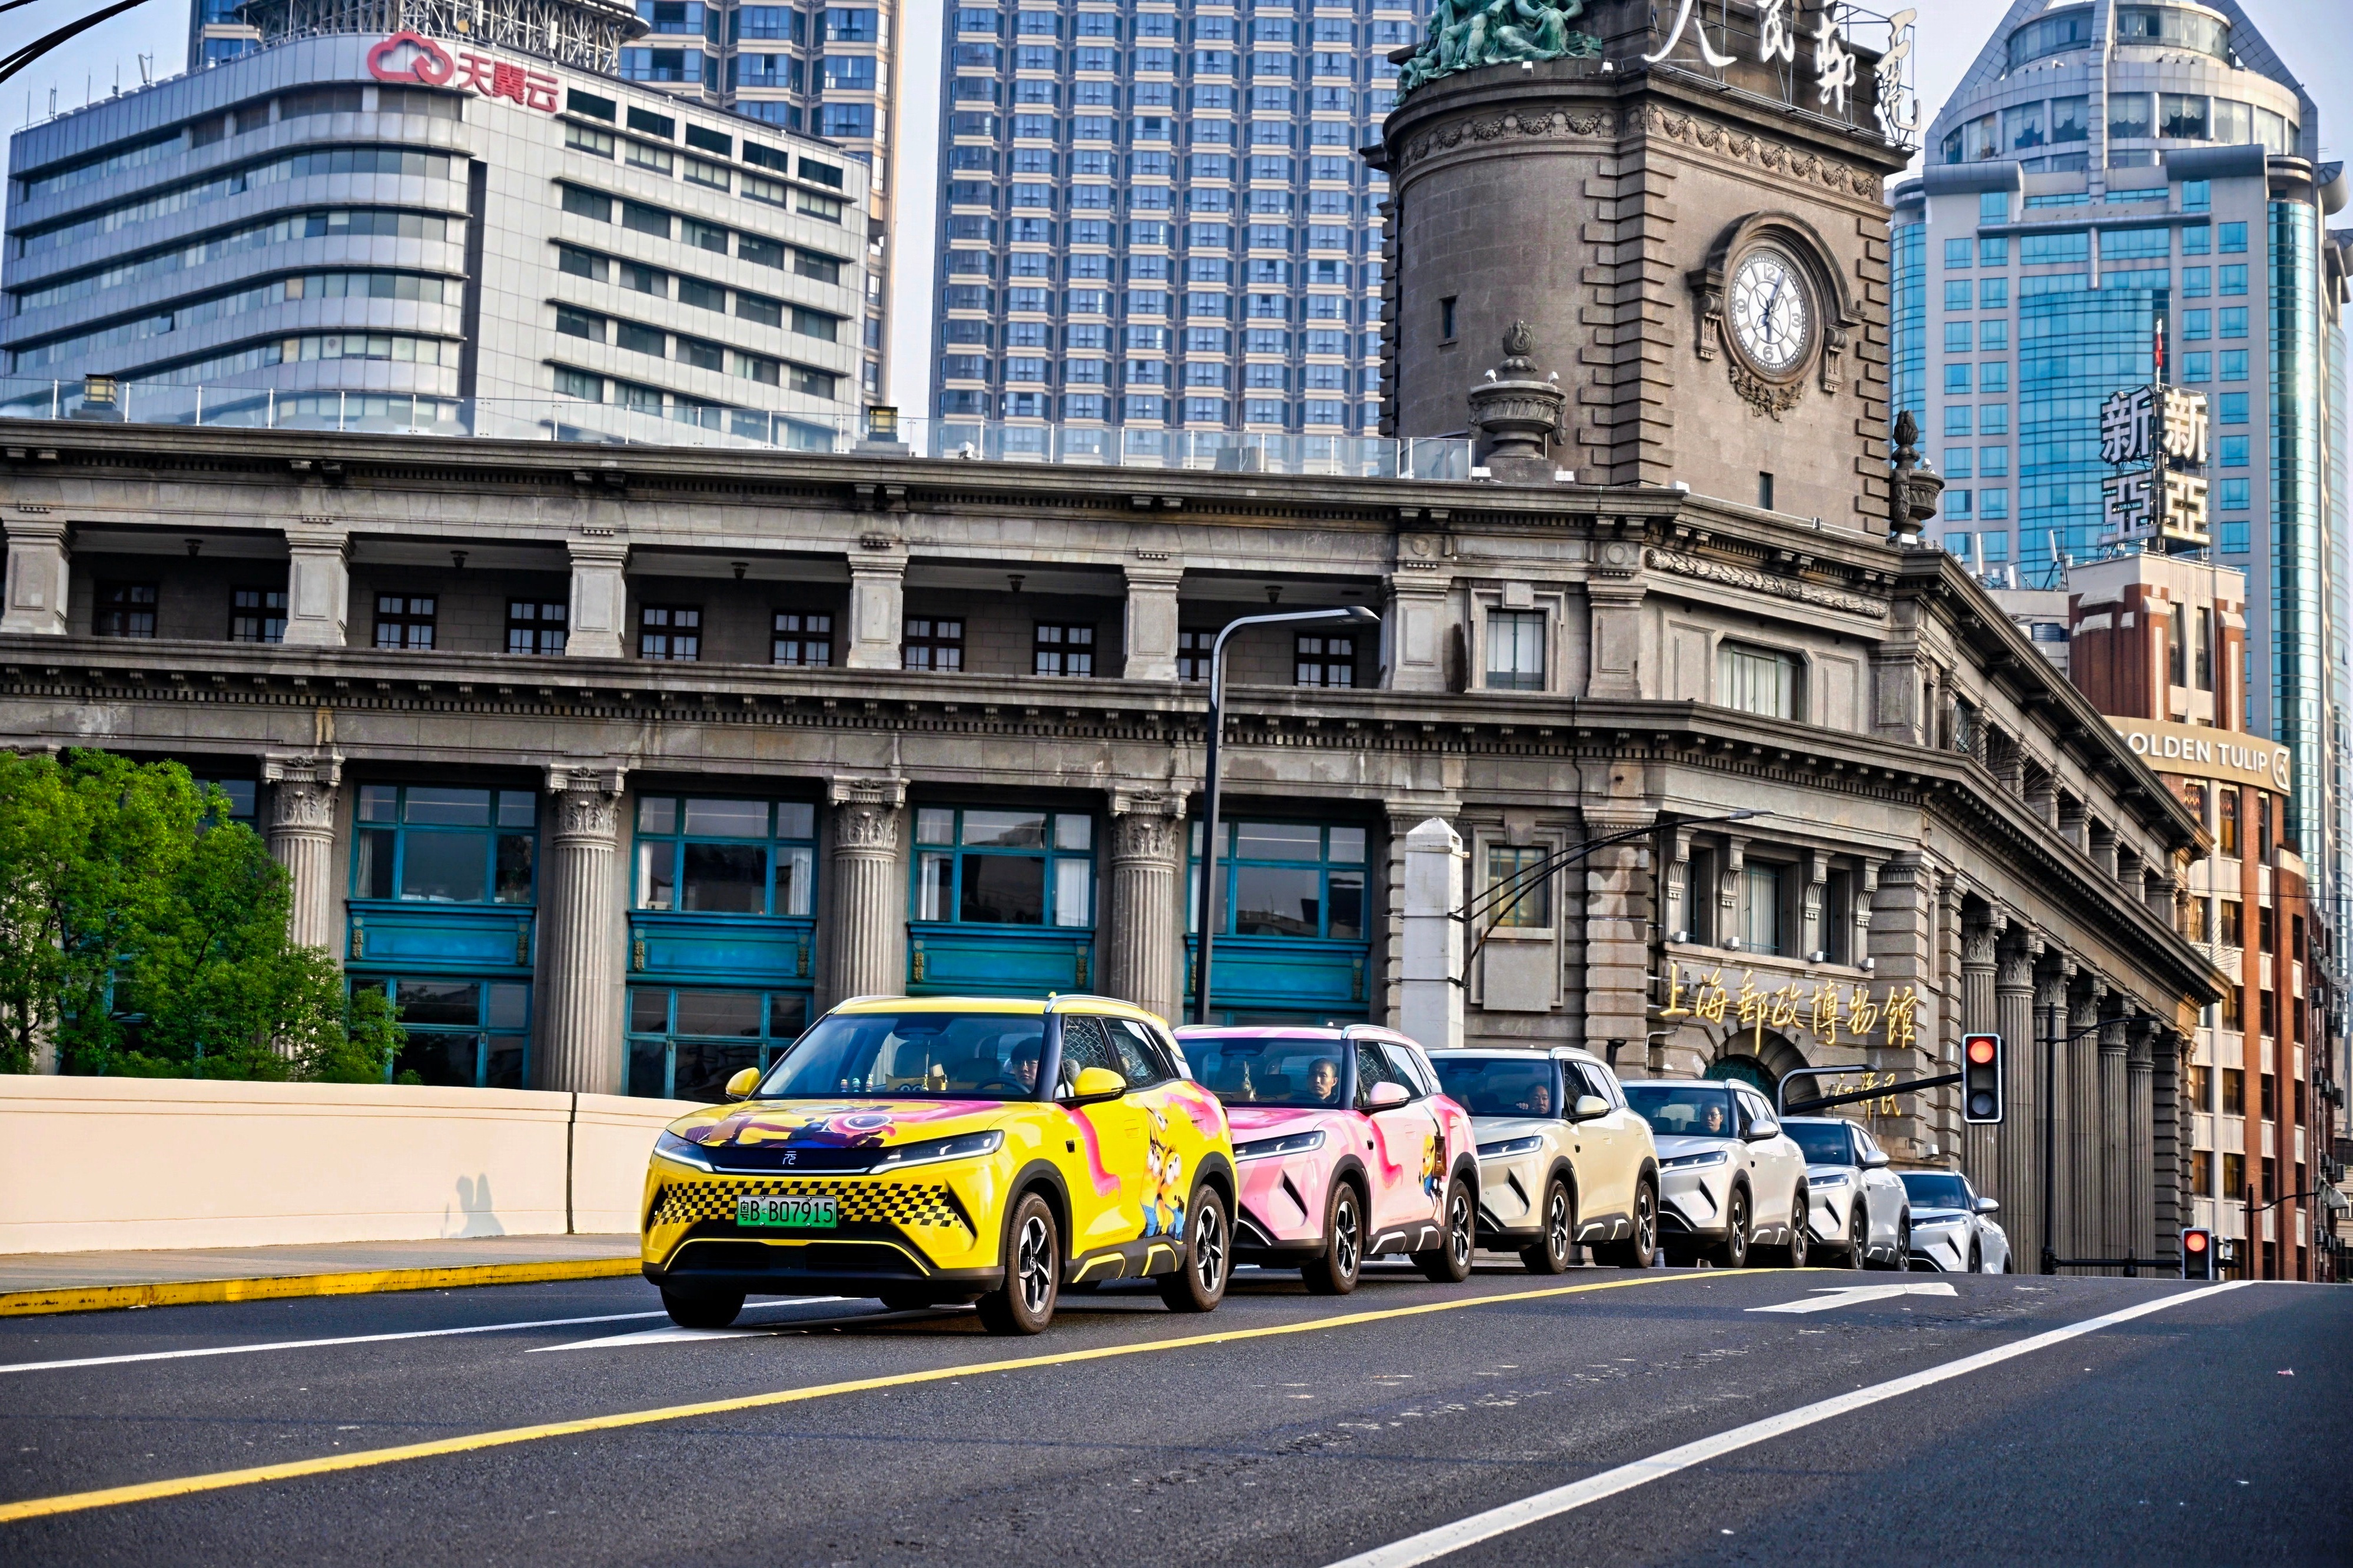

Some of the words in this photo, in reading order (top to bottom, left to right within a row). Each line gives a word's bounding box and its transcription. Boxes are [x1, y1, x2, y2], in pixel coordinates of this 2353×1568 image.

[459, 52, 559, 112] 天翼云
[1736, 298, 1747, 314] 9
[1791, 313, 1802, 328] 3
[1763, 346, 1774, 361] 6
[2116, 730, 2211, 763] OLDEN
[2216, 743, 2268, 773] TULIP
